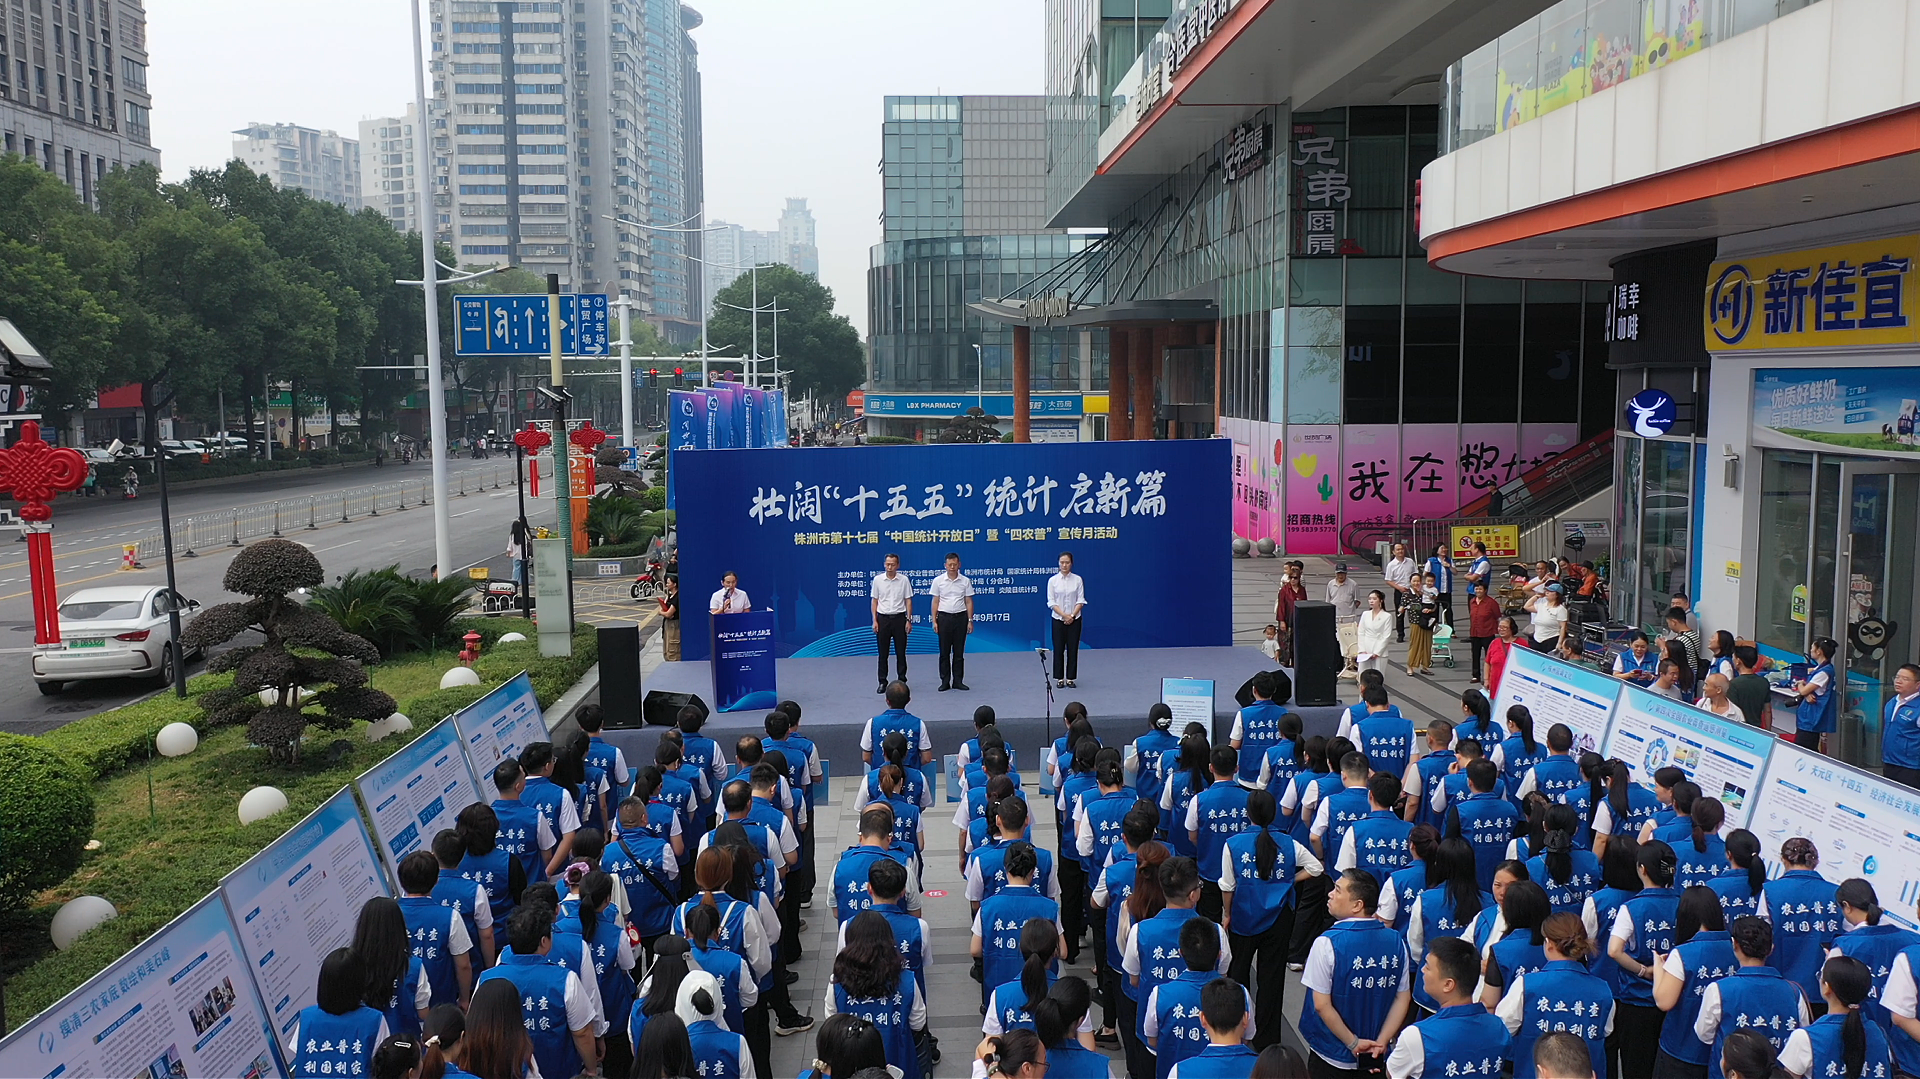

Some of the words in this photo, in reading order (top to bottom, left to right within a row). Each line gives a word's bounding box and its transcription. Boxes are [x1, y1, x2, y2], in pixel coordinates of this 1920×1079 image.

[1223, 123, 1263, 185] 兄弟厨房
[1292, 136, 1351, 255] 兄弟厨房
[1619, 282, 1640, 310] 瑞幸
[1764, 254, 1910, 335] 新佳宜
[580, 298, 592, 345] 世贸广场
[594, 310, 606, 345] 停车场
[1617, 313, 1639, 341] 咖啡
[1771, 378, 1837, 410] 优质好鲜奶
[1770, 403, 1836, 429] 每日新鲜送达
[1287, 514, 1336, 526] 招商热线
[1852, 517, 1875, 529] Coffee
[880, 727, 914, 738] 农查
[1369, 736, 1406, 746] 农业普查
[1144, 750, 1160, 758] 农业
[1810, 765, 1834, 782] 天元区
[1208, 807, 1248, 819] 农业普查
[895, 817, 913, 828] 普查
[1100, 821, 1121, 831] 农业
[1473, 818, 1513, 830] 农业普查
[1623, 822, 1643, 831] 利国
[495, 828, 526, 840] 业普查
[1100, 835, 1120, 845] 利国
[1365, 837, 1410, 851] 农业普查
[611, 858, 654, 873] 农业查
[1240, 851, 1286, 865] 农查
[1366, 852, 1408, 867] 利国利家
[994, 867, 1041, 882] 农查
[1241, 866, 1285, 880] 利家
[848, 880, 869, 893] 农业
[1546, 873, 1593, 890] 农普查
[848, 898, 871, 911] 利国
[1720, 896, 1757, 909] 农业普
[1781, 901, 1838, 916] 农业普查
[1644, 919, 1672, 933] 农业
[1782, 920, 1839, 932] 利国利家
[993, 936, 1017, 950] 利国
[1645, 938, 1671, 951] 利国
[412, 946, 437, 960] 利家
[1152, 946, 1181, 961] 农业
[1352, 954, 1400, 971] 农业普查
[1151, 966, 1179, 980] 利国
[1697, 965, 1737, 979] 农业普
[1350, 974, 1397, 990] 利国利家
[58, 983, 119, 1039] 摸清三农家底
[118, 946, 171, 996] 数绘和美石峰
[522, 996, 549, 1011] 普查
[1537, 997, 1600, 1018] 农业普查
[1006, 1009, 1033, 1024] 农业
[1172, 1004, 1200, 1020] 农业
[524, 1017, 550, 1031] 利家
[1736, 1012, 1798, 1031] 农业普查
[305, 1039, 362, 1055] 农业普查
[304, 1059, 362, 1076] 利国利家
[696, 1060, 726, 1077] 普查
